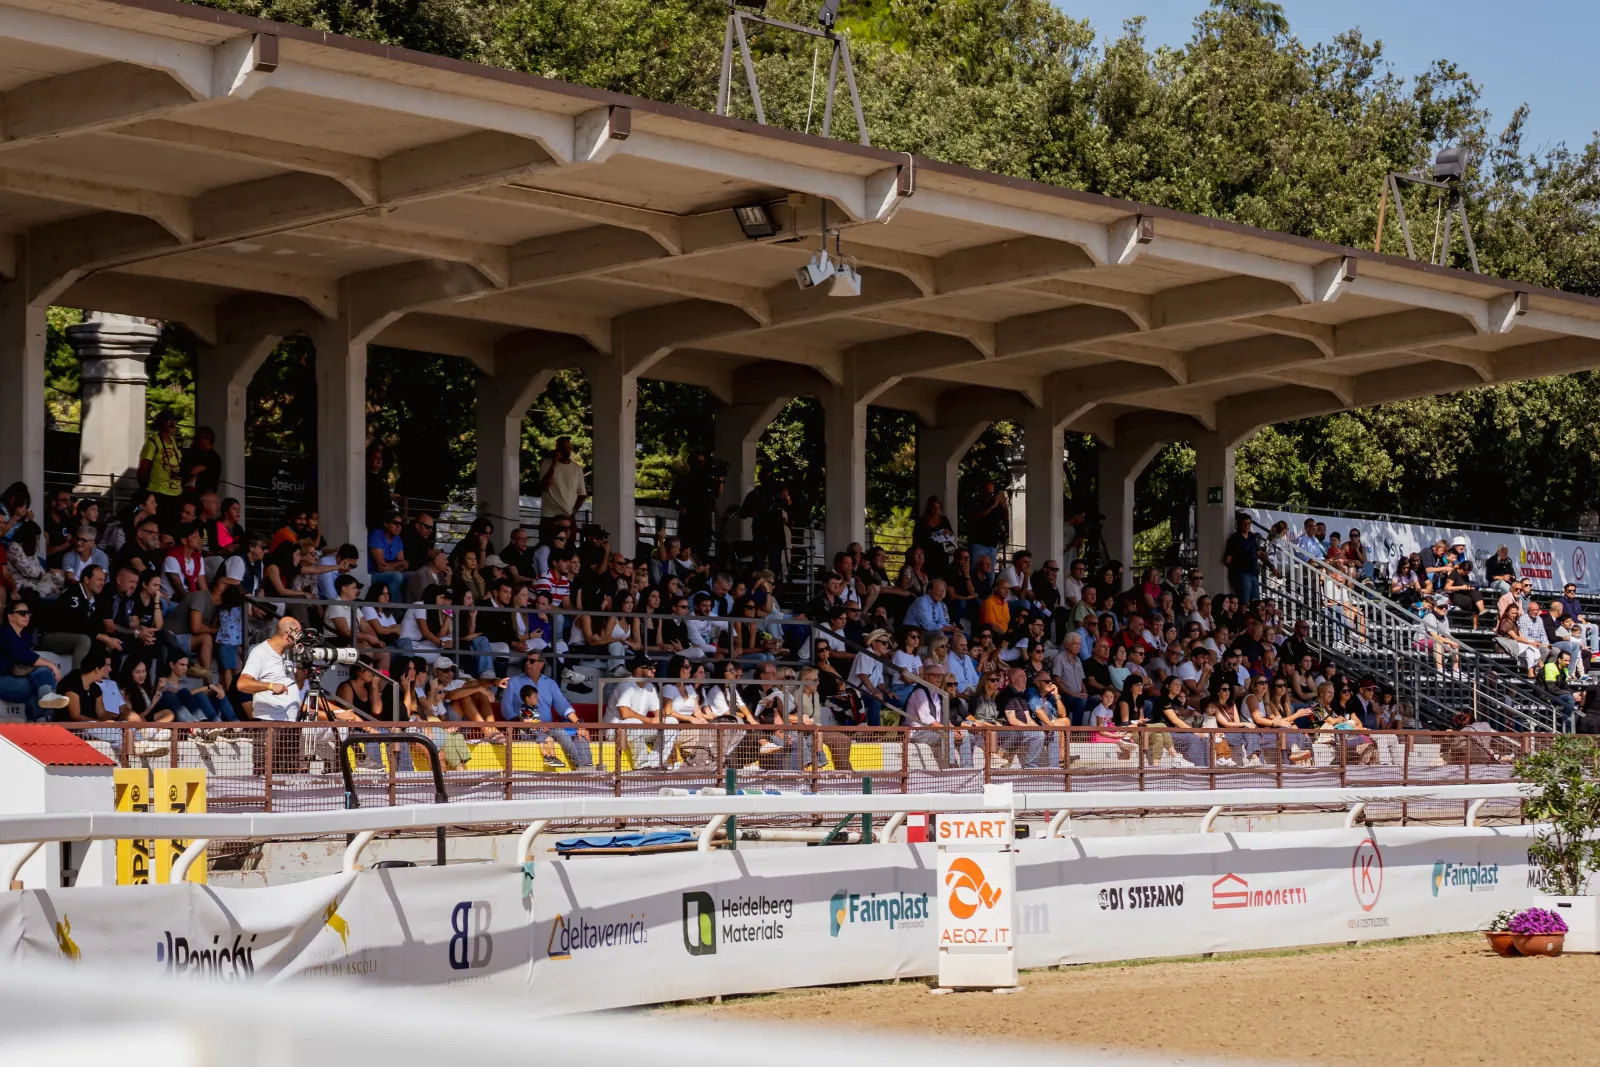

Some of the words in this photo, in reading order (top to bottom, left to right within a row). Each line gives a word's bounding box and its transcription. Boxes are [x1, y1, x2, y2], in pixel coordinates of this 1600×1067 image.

[1526, 550, 1552, 566] CONAD
[71, 596, 79, 608] 3
[940, 820, 1006, 839] START
[1444, 861, 1498, 892] Fainplast
[721, 895, 793, 919] Heidelberg
[1109, 887, 1124, 910] DI
[1128, 883, 1184, 909] STEFANO
[849, 891, 929, 930] Fainplast
[722, 919, 784, 943] Materials
[940, 928, 1009, 944] AEQZ.IT
[175, 933, 256, 983] Panichi
[332, 963, 342, 977] DI
[346, 960, 377, 976] ASCOLI
